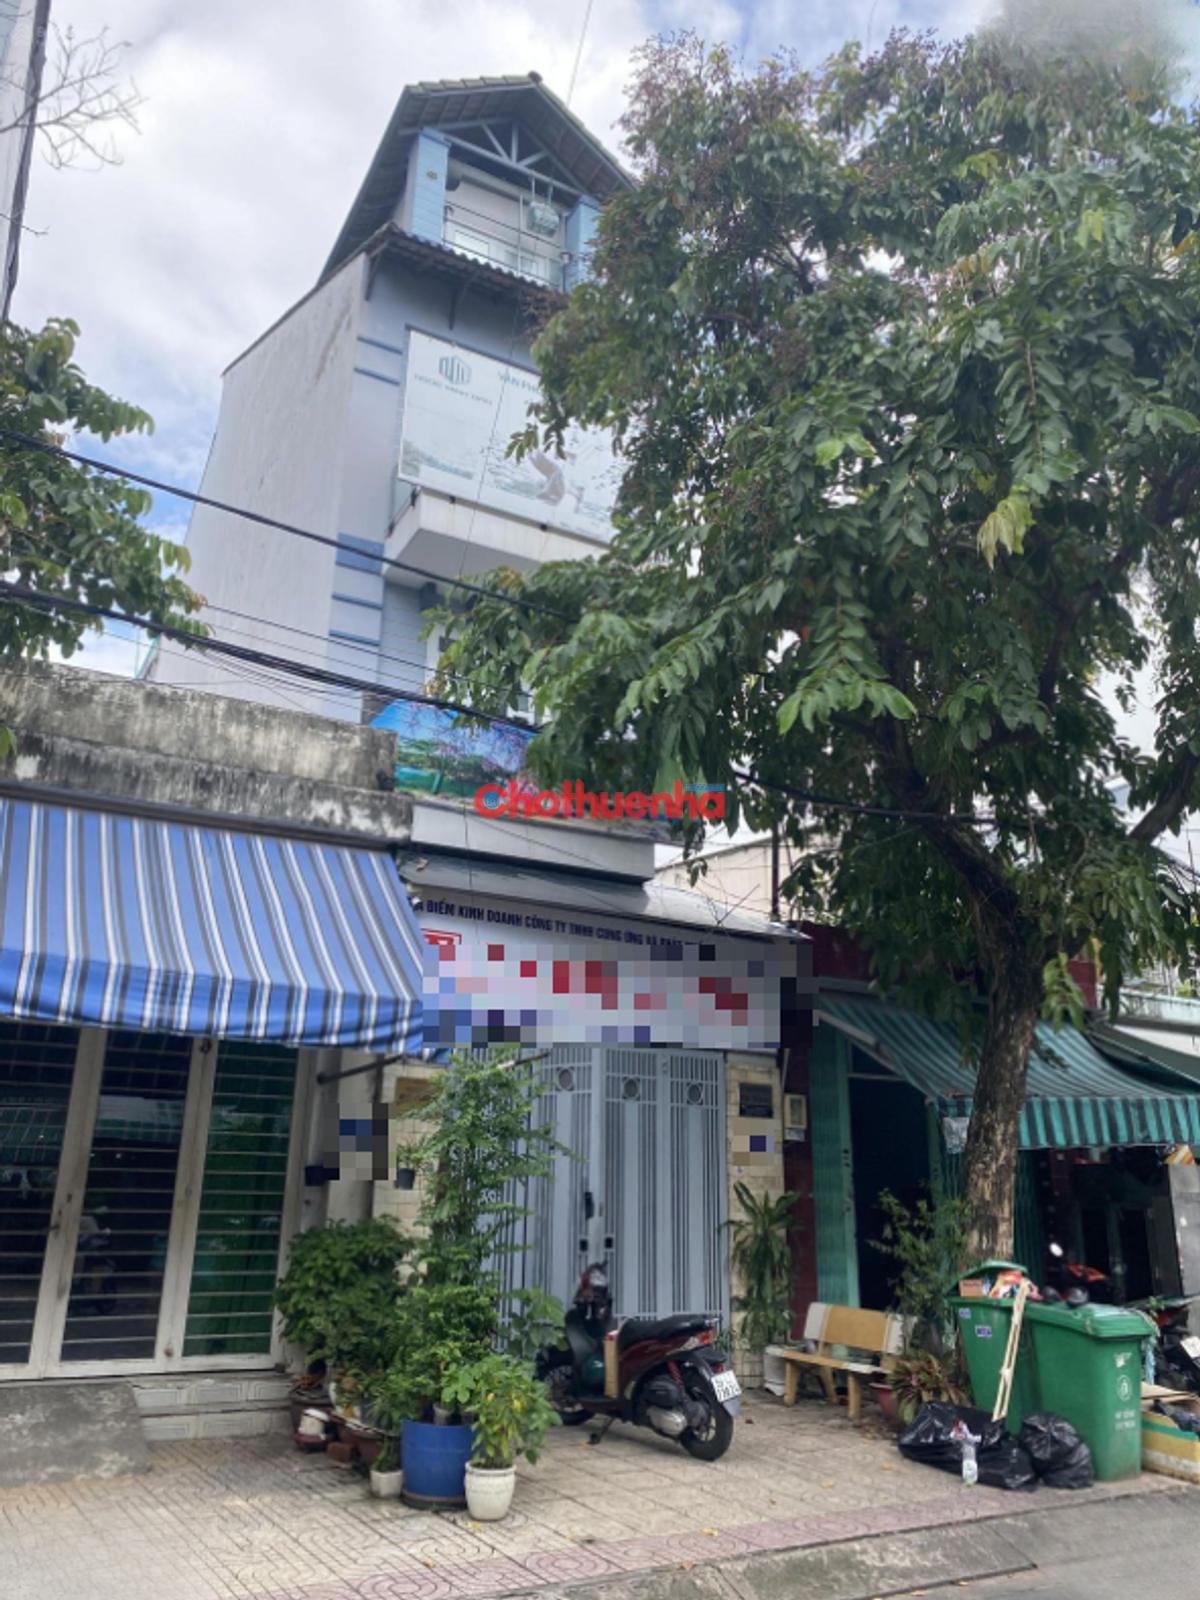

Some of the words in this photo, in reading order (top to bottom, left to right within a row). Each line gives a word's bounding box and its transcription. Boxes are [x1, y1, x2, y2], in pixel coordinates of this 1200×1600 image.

[458, 905, 484, 920] KINH
[487, 909, 523, 926] DOANH
[555, 919, 567, 933] TY
[569, 923, 594, 937] TNHH
